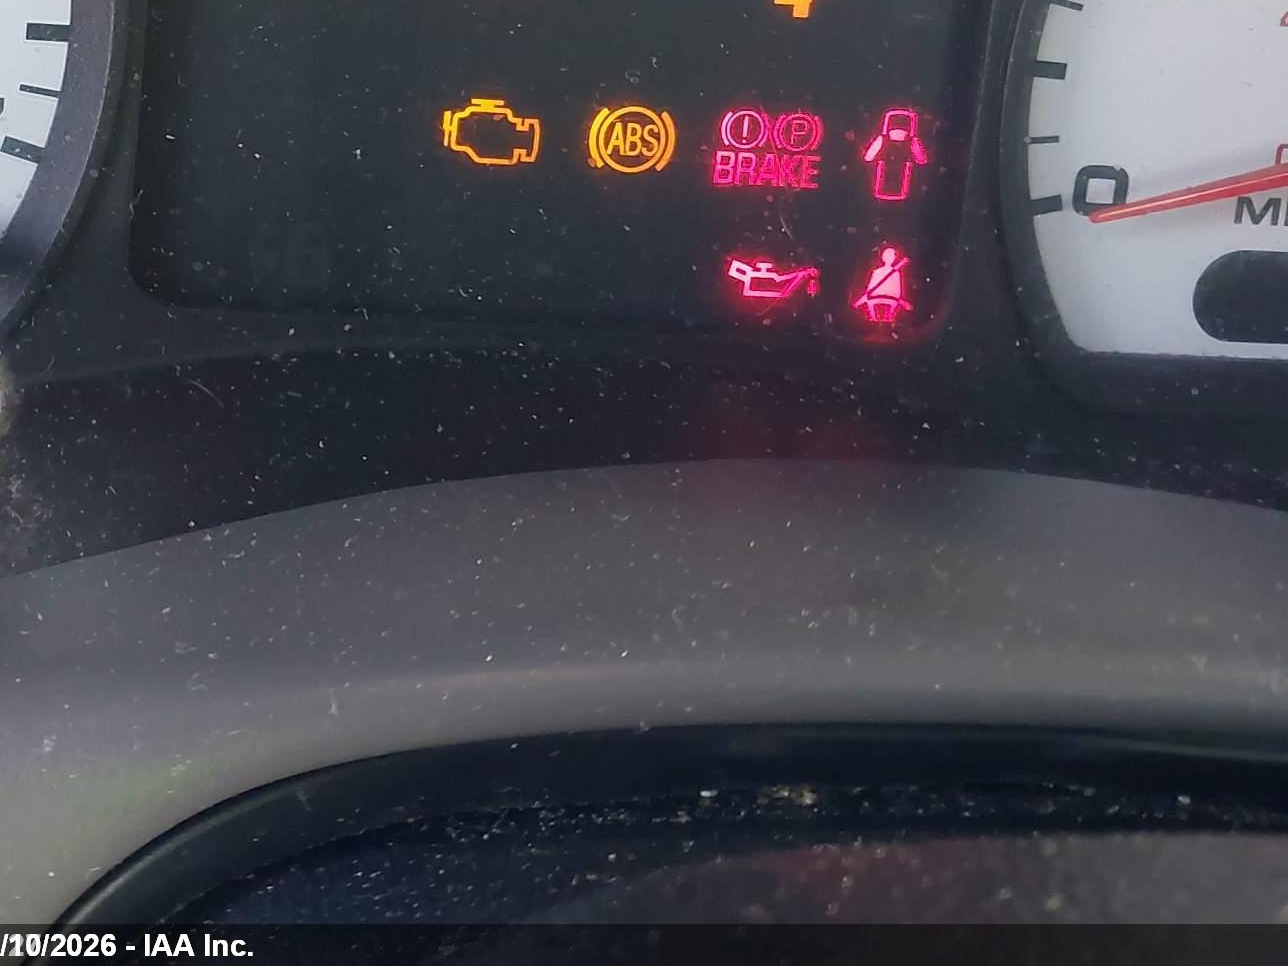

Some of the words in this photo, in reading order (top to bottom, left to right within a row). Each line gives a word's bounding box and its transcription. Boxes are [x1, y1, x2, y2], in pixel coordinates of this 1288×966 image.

[606, 121, 660, 158] ABS
[713, 150, 822, 189] BRAKE
[1072, 164, 1130, 217] 0
